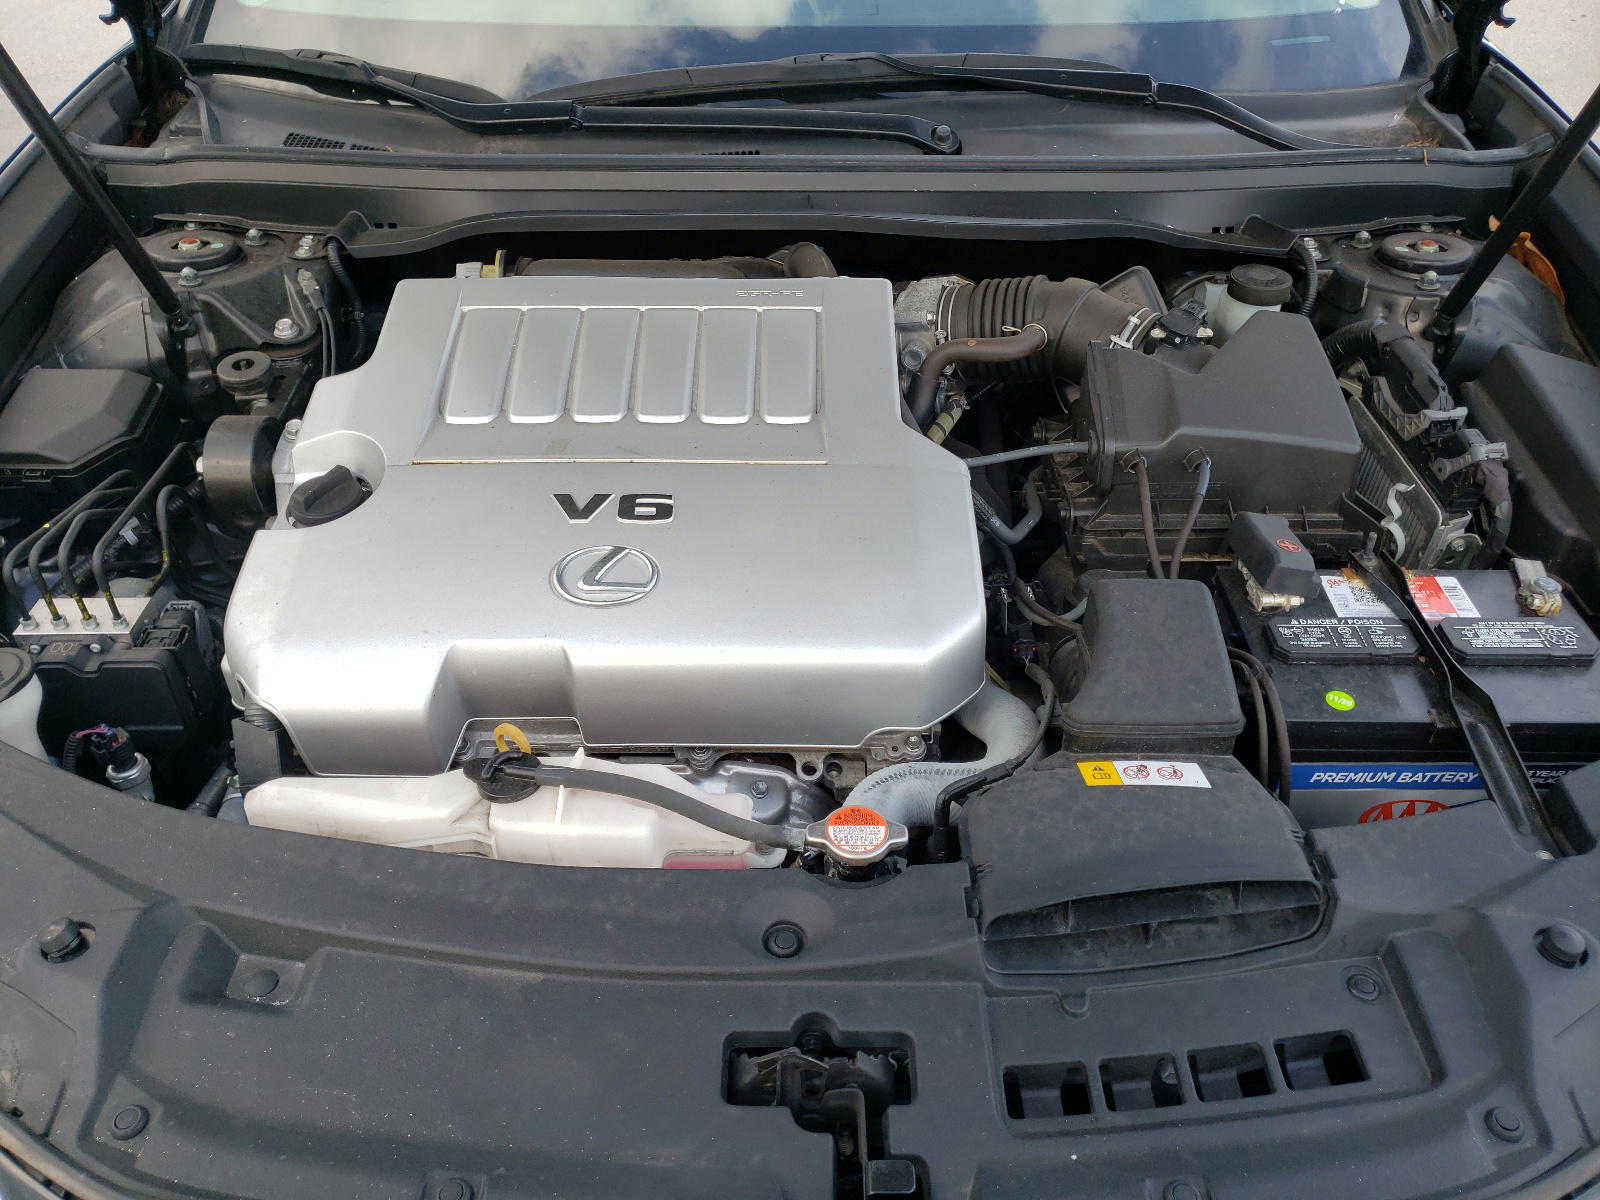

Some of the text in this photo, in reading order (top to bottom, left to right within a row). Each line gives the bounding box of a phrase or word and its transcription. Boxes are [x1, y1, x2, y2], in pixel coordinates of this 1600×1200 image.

[550, 493, 675, 524] V6
[1328, 694, 1353, 707] 11/20
[1309, 771, 1479, 784] PREMIUM BATTERY
